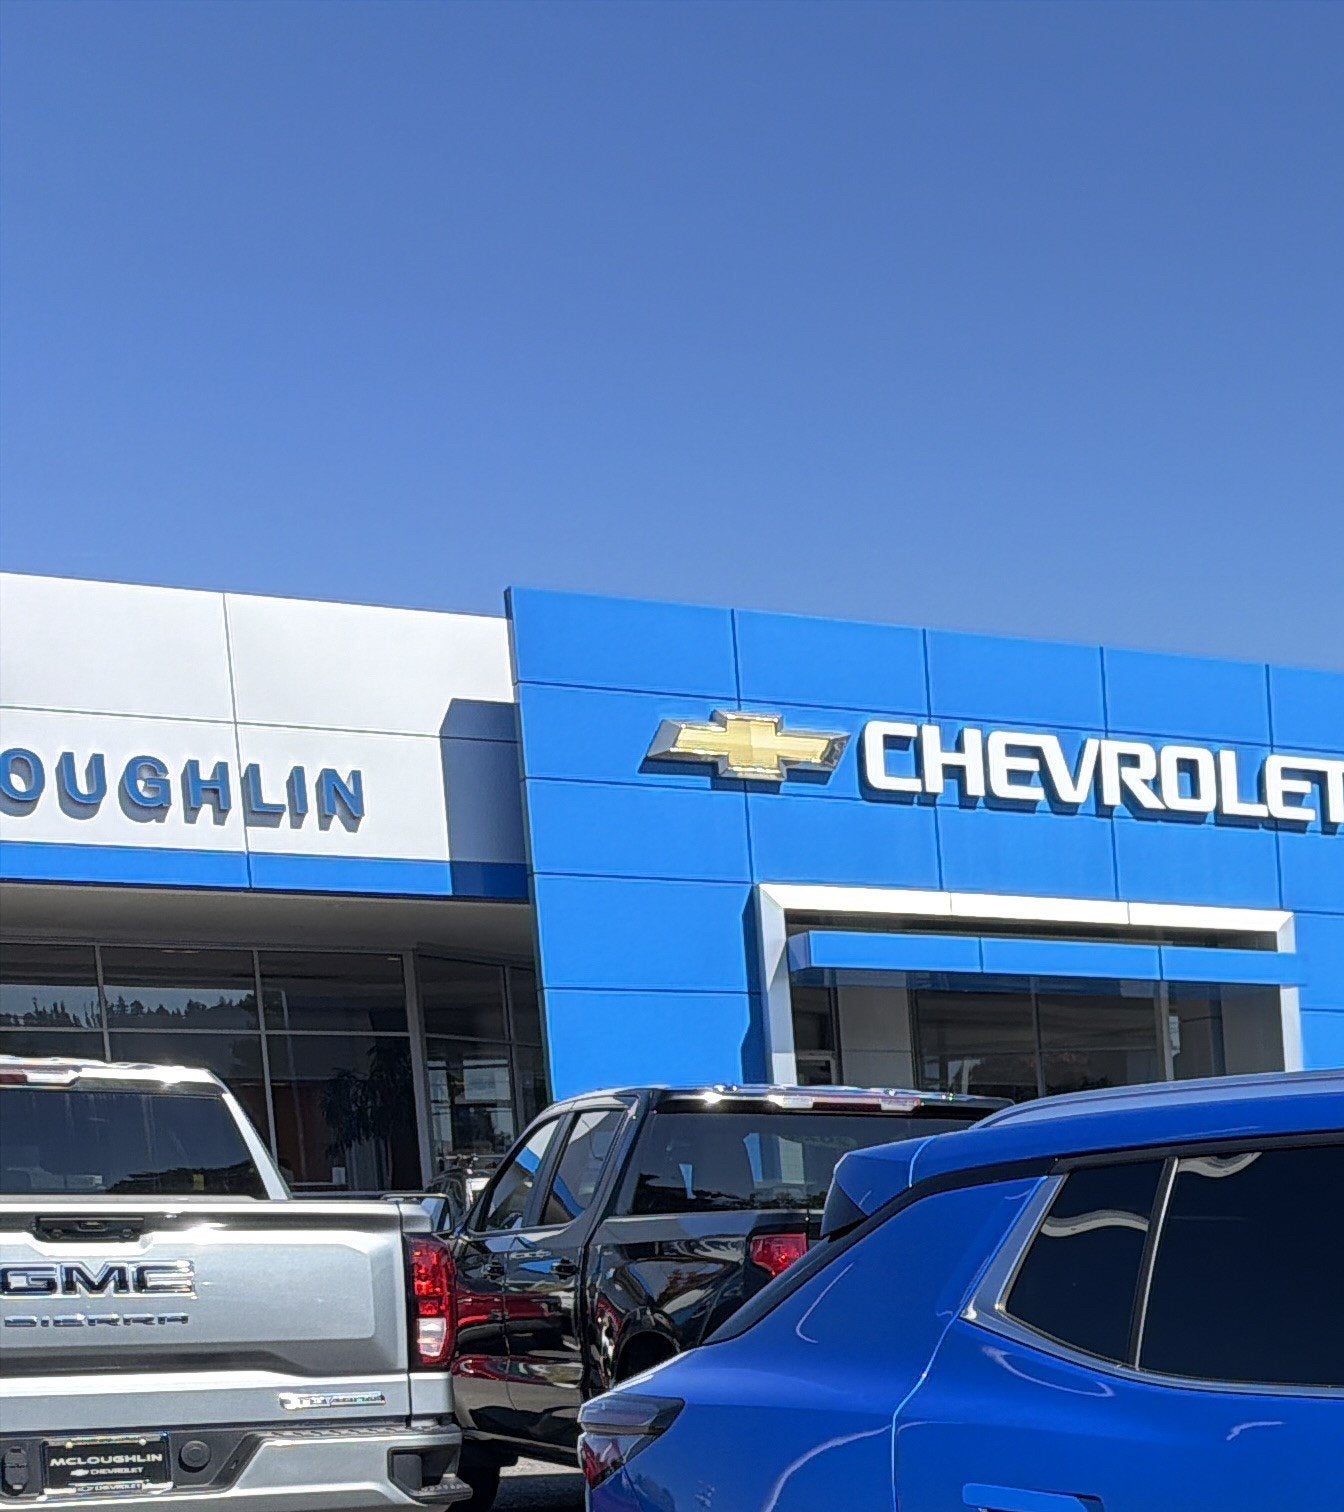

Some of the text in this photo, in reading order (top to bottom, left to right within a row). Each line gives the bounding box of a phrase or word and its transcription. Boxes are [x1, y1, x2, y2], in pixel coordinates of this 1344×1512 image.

[0, 747, 365, 820] OUGHLIN
[0, 1261, 193, 1298] GMC
[4, 1312, 190, 1327] SIERRA
[50, 1453, 163, 1466] MCLOUGHLIN
[90, 1466, 144, 1475] CHEVROLET
